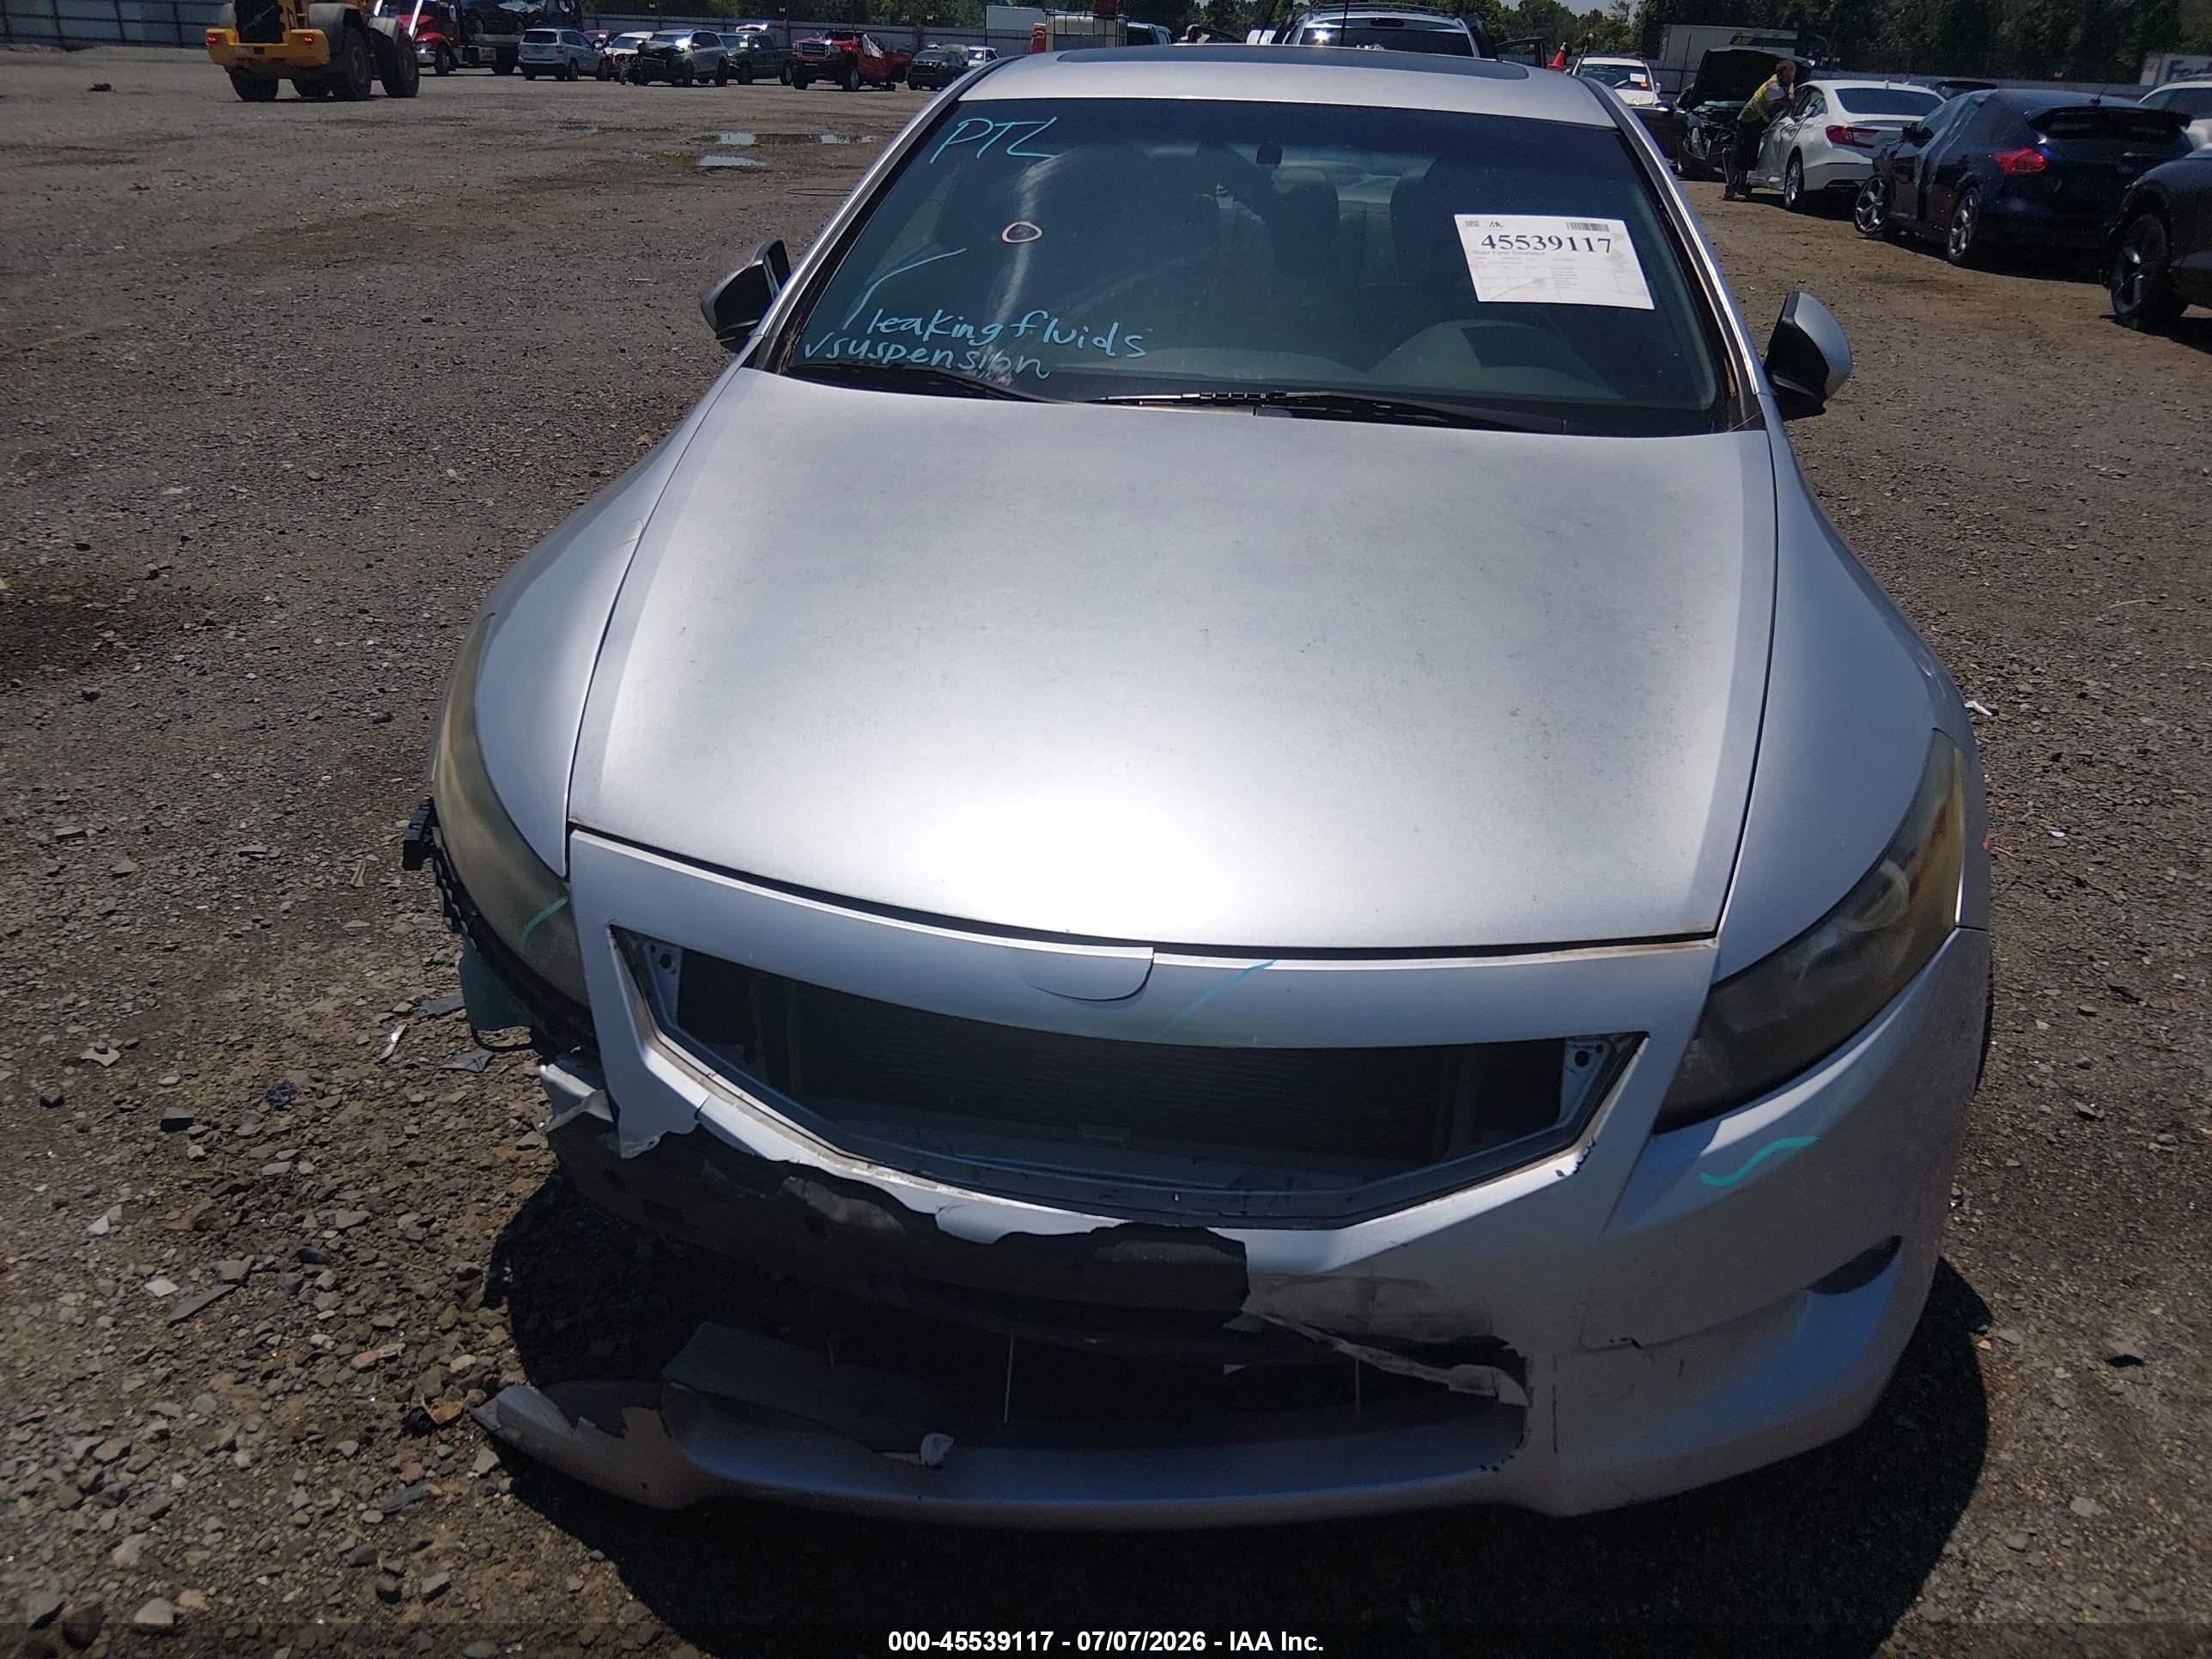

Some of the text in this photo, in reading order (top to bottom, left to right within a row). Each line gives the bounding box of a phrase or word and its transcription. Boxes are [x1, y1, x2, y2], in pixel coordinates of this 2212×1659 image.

[930, 117, 1058, 164] PTL
[1481, 234, 1612, 253] 45539117
[866, 309, 1148, 359] leaking fluids
[826, 339, 1051, 379] suspension
